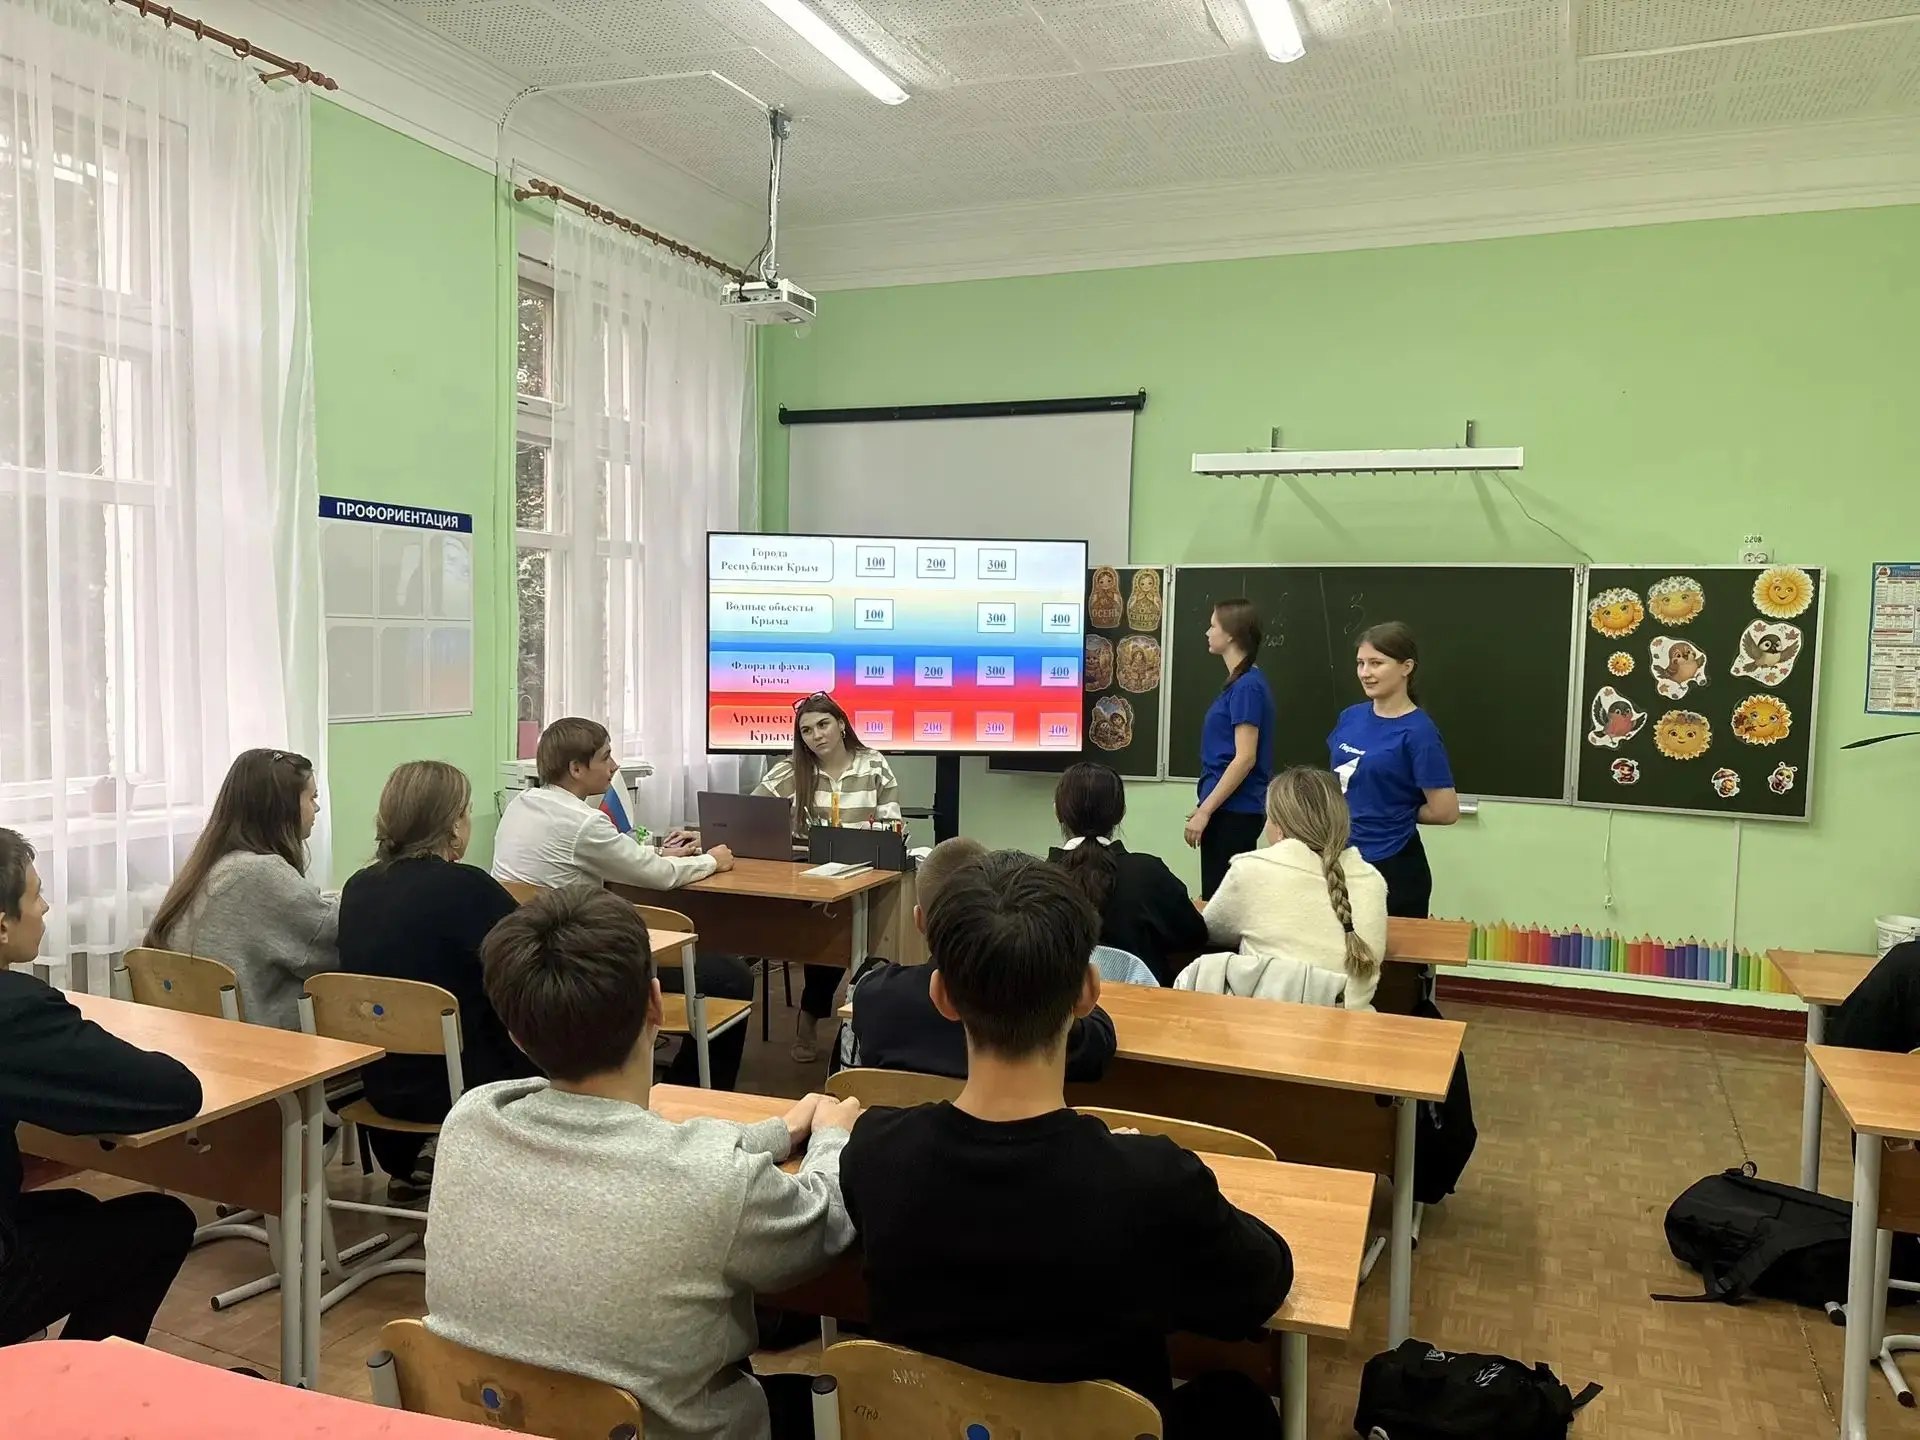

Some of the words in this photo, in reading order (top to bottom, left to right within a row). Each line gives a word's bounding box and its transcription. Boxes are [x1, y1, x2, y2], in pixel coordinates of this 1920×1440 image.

[336, 501, 459, 529] ПРОФОРИЕНТАЦИЯ
[751, 547, 788, 559] Города
[721, 561, 783, 574] Республики
[787, 562, 819, 574] Крым
[865, 556, 885, 569] 100
[926, 558, 946, 570] 200
[987, 559, 1007, 572] 300
[726, 601, 767, 612] Водные
[1092, 608, 1120, 618] ОСЕНЬ
[751, 616, 789, 627] Крыма
[864, 609, 884, 621] 100
[986, 612, 1006, 625] 300
[1050, 613, 1071, 626] 400
[731, 660, 766, 672] Флора
[778, 661, 810, 673] фауна
[864, 665, 884, 678] 100
[923, 666, 944, 678] 200
[985, 665, 1005, 678] 300
[1050, 666, 1070, 678] 400
[752, 674, 790, 686] Крыма
[730, 711, 793, 726] Архитект
[864, 720, 884, 733] 100
[923, 721, 942, 734] 200
[985, 722, 1005, 734] 300
[1049, 724, 1069, 737] 400
